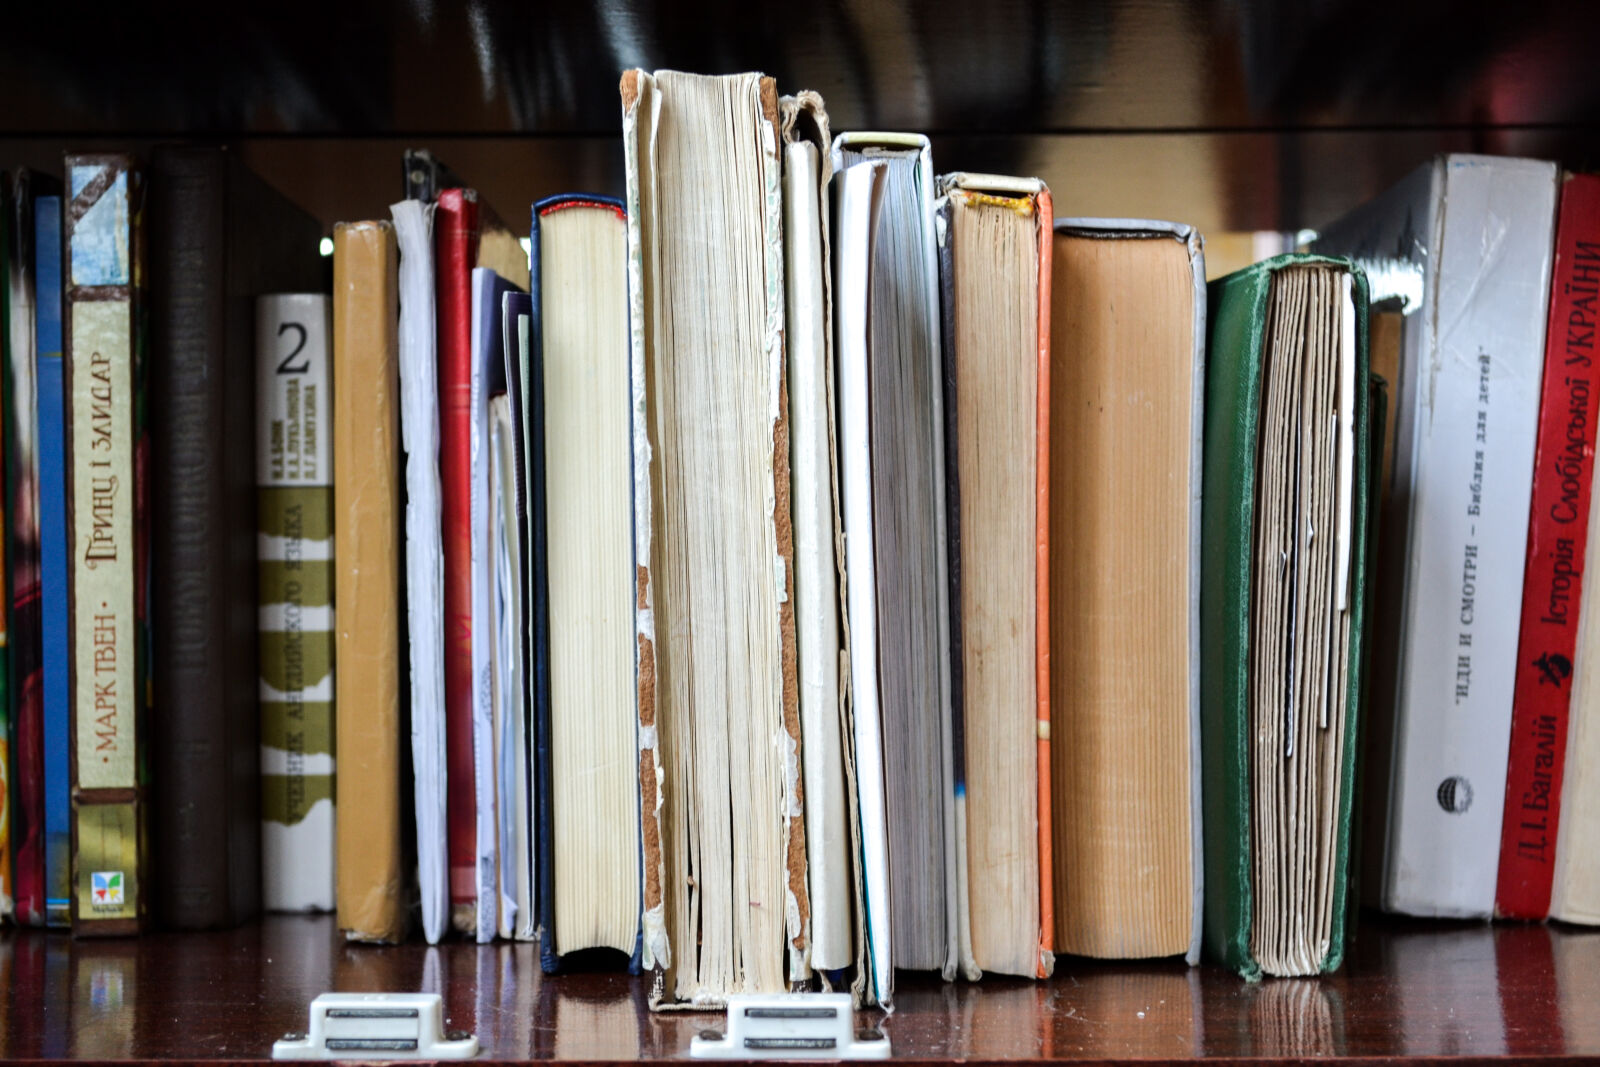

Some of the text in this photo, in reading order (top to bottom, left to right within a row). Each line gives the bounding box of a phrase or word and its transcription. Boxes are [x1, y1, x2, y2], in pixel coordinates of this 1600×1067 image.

[276, 321, 311, 375] 2
[1476, 410, 1487, 443] для
[1540, 240, 1600, 627] Історія Слобідської УКРАЇНИ
[1467, 450, 1484, 517] Библия
[1460, 544, 1479, 626] СМОТРИ
[284, 503, 305, 824] УЧЕБНИК АНГЛИЙСКОГО ЯЗЫКА
[1459, 632, 1473, 647] И
[94, 614, 117, 752] МАРК ТВЕН
